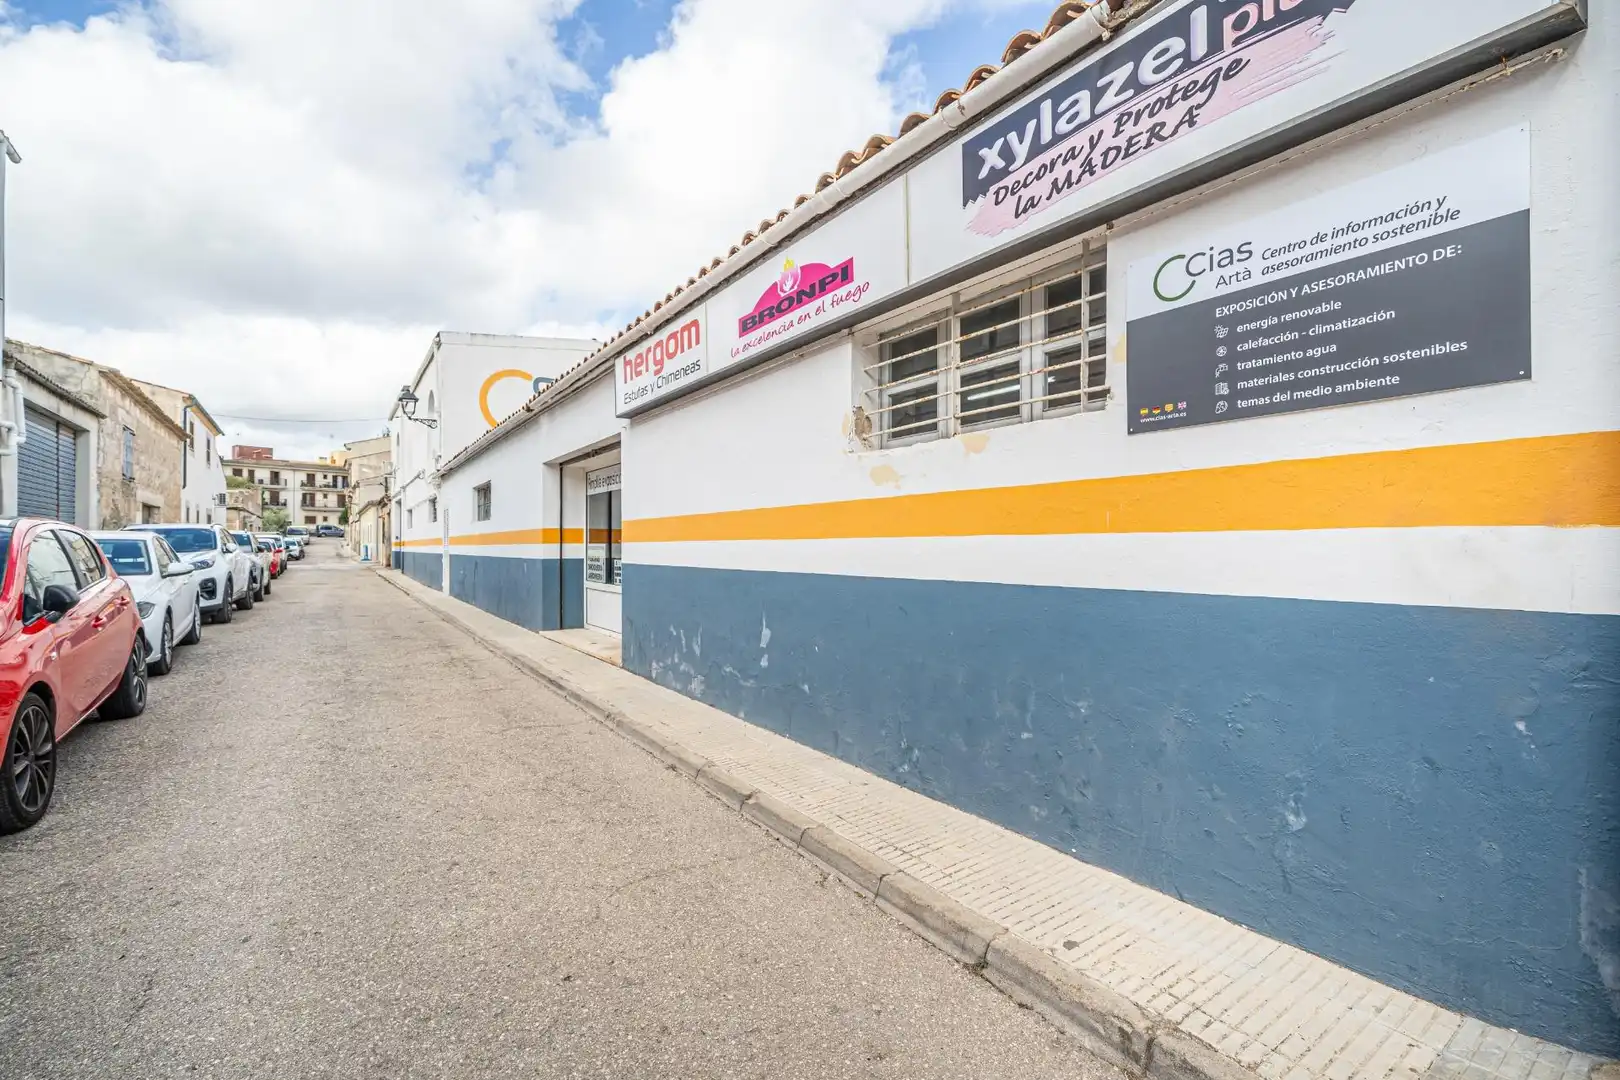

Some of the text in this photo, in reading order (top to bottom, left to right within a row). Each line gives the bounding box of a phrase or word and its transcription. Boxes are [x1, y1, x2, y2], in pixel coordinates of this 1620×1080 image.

[978, 5, 1208, 179] xylazel
[993, 57, 1252, 206] Decora y Protege
[1014, 103, 1202, 219] la MADERA
[1261, 195, 1448, 261] Centro de información y
[1261, 208, 1461, 276] asesoramiento sostenible
[742, 265, 849, 332] BRONPI
[1215, 267, 1252, 289] Artà
[1215, 244, 1462, 318] EXPOSICIÓN Y ASESORAMIENTO DE:
[730, 281, 870, 358] la excelencia en el fuego
[1236, 301, 1342, 333] energía renovable
[1236, 331, 1299, 352] calefacción
[1308, 310, 1396, 336] climatización
[623, 319, 700, 384] hergom
[624, 359, 701, 404] Estufas y Chimeneas
[1236, 344, 1337, 370] tratamiento agua
[1237, 341, 1468, 389] materiales construcción sostenibles
[1237, 375, 1400, 408] temas del medio ambiente
